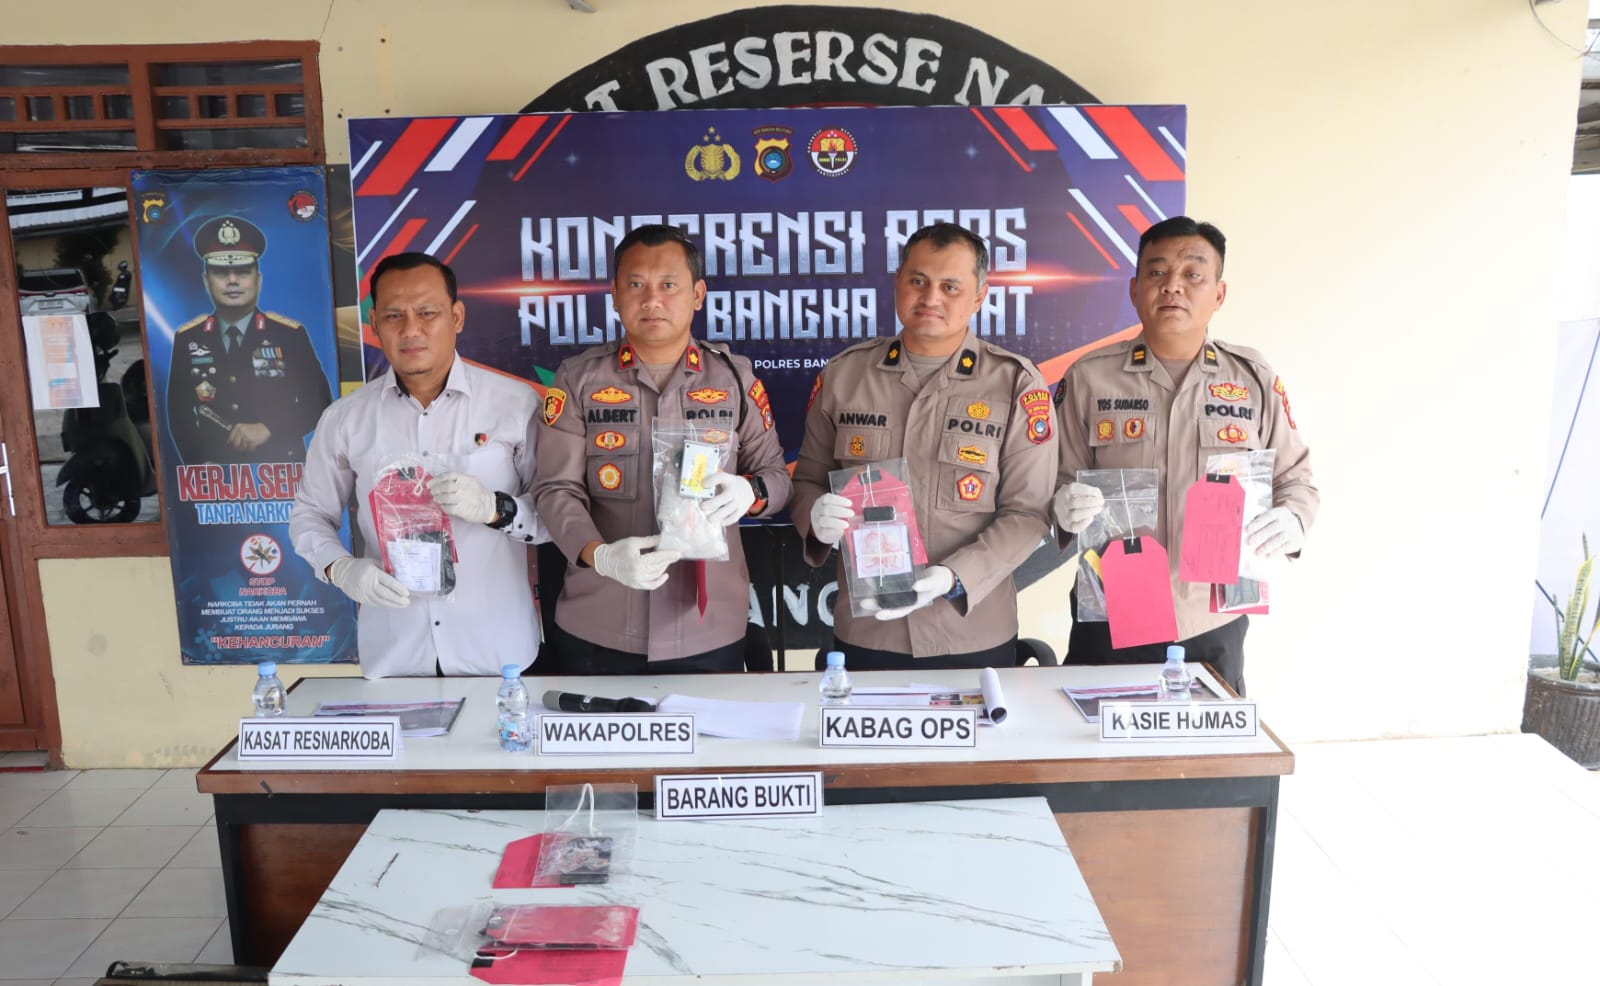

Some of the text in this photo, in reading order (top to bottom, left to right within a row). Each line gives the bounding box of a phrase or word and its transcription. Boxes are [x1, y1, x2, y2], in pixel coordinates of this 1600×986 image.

[646, 31, 943, 111] RESERSE
[520, 213, 866, 281] KONRENSI
[706, 287, 877, 341] BANGKA
[754, 359, 801, 369] POLRES
[588, 409, 637, 423] ALBERT
[839, 412, 888, 427] ANWAR
[1205, 404, 1253, 421] POLRI
[948, 418, 1002, 438] POLRI
[177, 462, 304, 501] KERJA SEH
[195, 501, 294, 525] TANPA NARKO
[239, 586, 287, 596] NARKOBA
[201, 608, 237, 616] MEMBUAT
[263, 607, 295, 615] MENJADI
[208, 600, 242, 608] NARKOBA
[287, 599, 317, 607] PERNAH
[264, 623, 294, 631] JURANG
[270, 615, 307, 623] MEMBAWA
[211, 635, 330, 649] "KEHANCURAN"
[826, 715, 971, 740] KABAG OPS
[1112, 710, 1248, 731] KASIE HUMAS
[244, 729, 391, 750] KASAT RESNARKOBA
[544, 721, 691, 743] WAKAPOLRES
[667, 784, 811, 810] BARANG BUKTI
